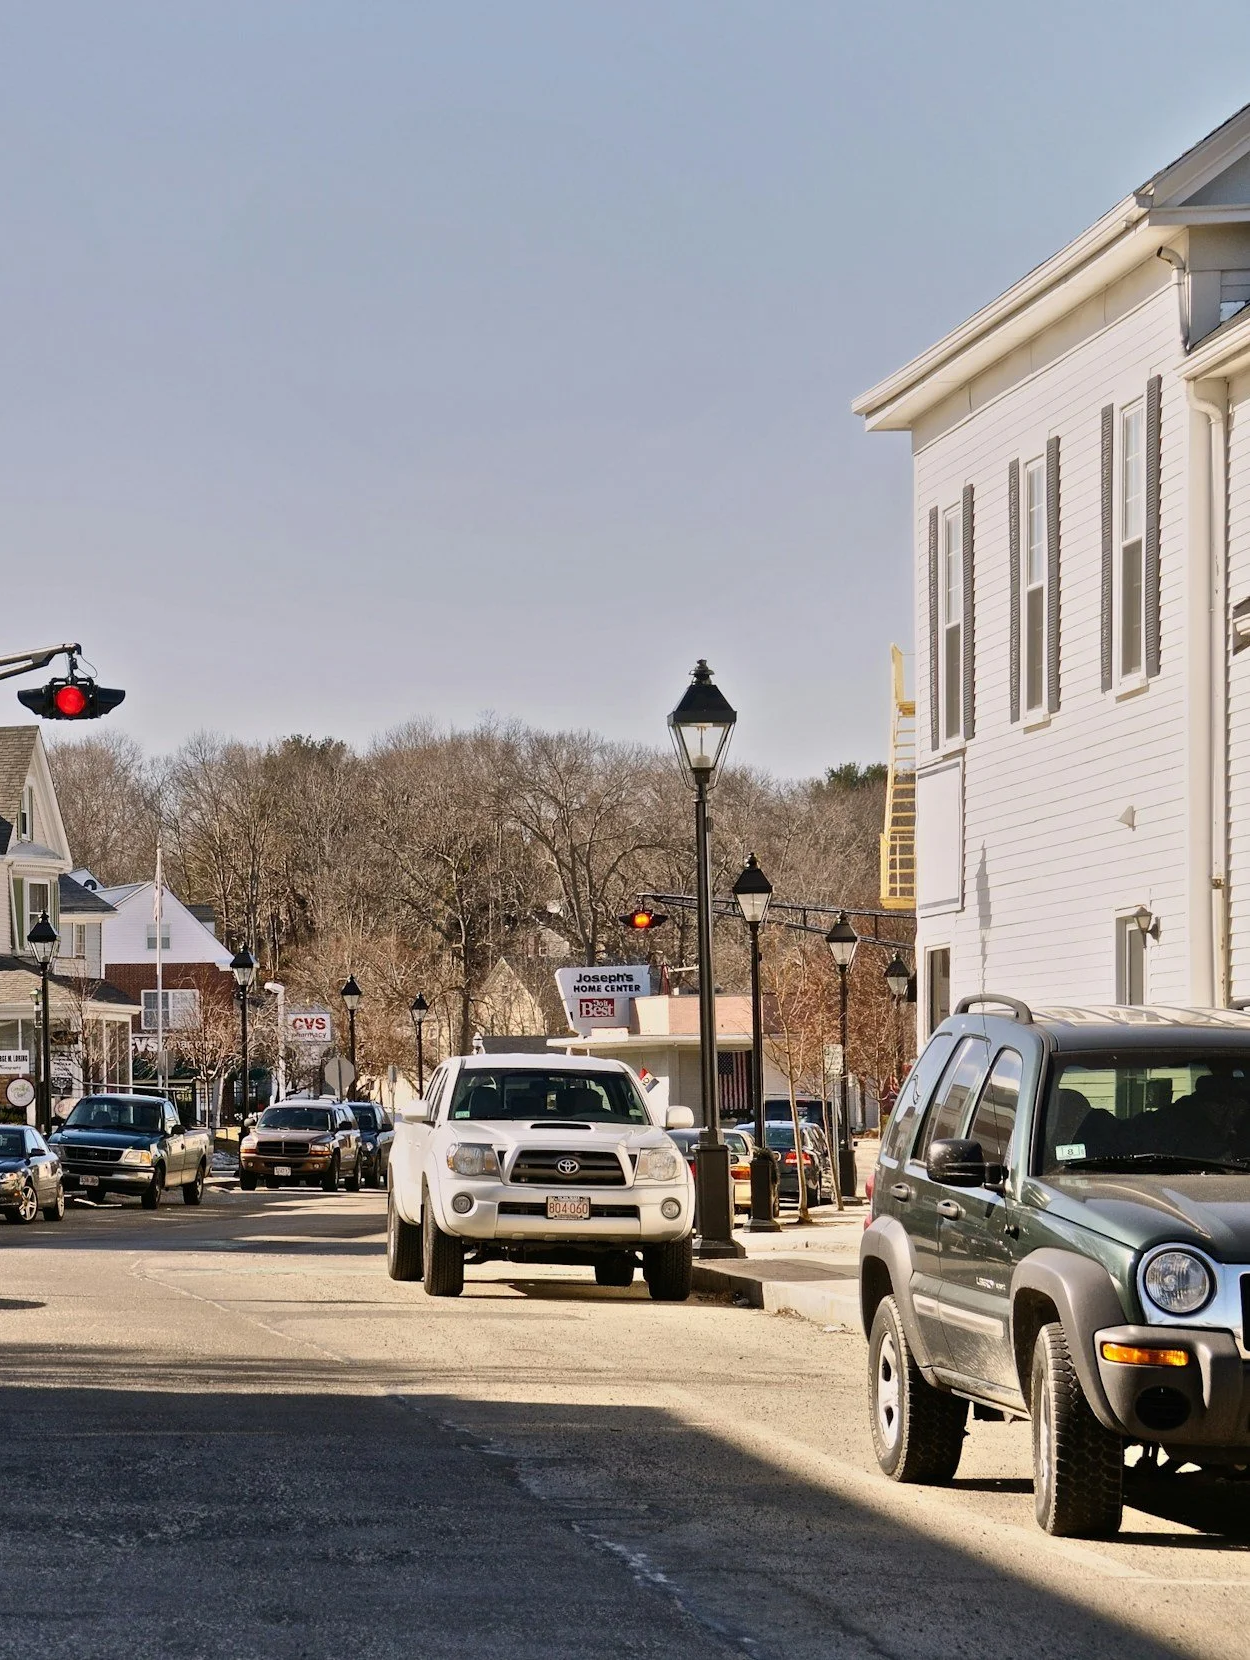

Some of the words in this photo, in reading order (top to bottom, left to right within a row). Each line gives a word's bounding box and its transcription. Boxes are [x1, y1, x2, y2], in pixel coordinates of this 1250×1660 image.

[576, 973, 633, 983] Joseph's
[573, 985, 601, 993] HOME
[581, 1002, 614, 1017] Best
[292, 1017, 327, 1030] CVS
[130, 1037, 159, 1053] VS
